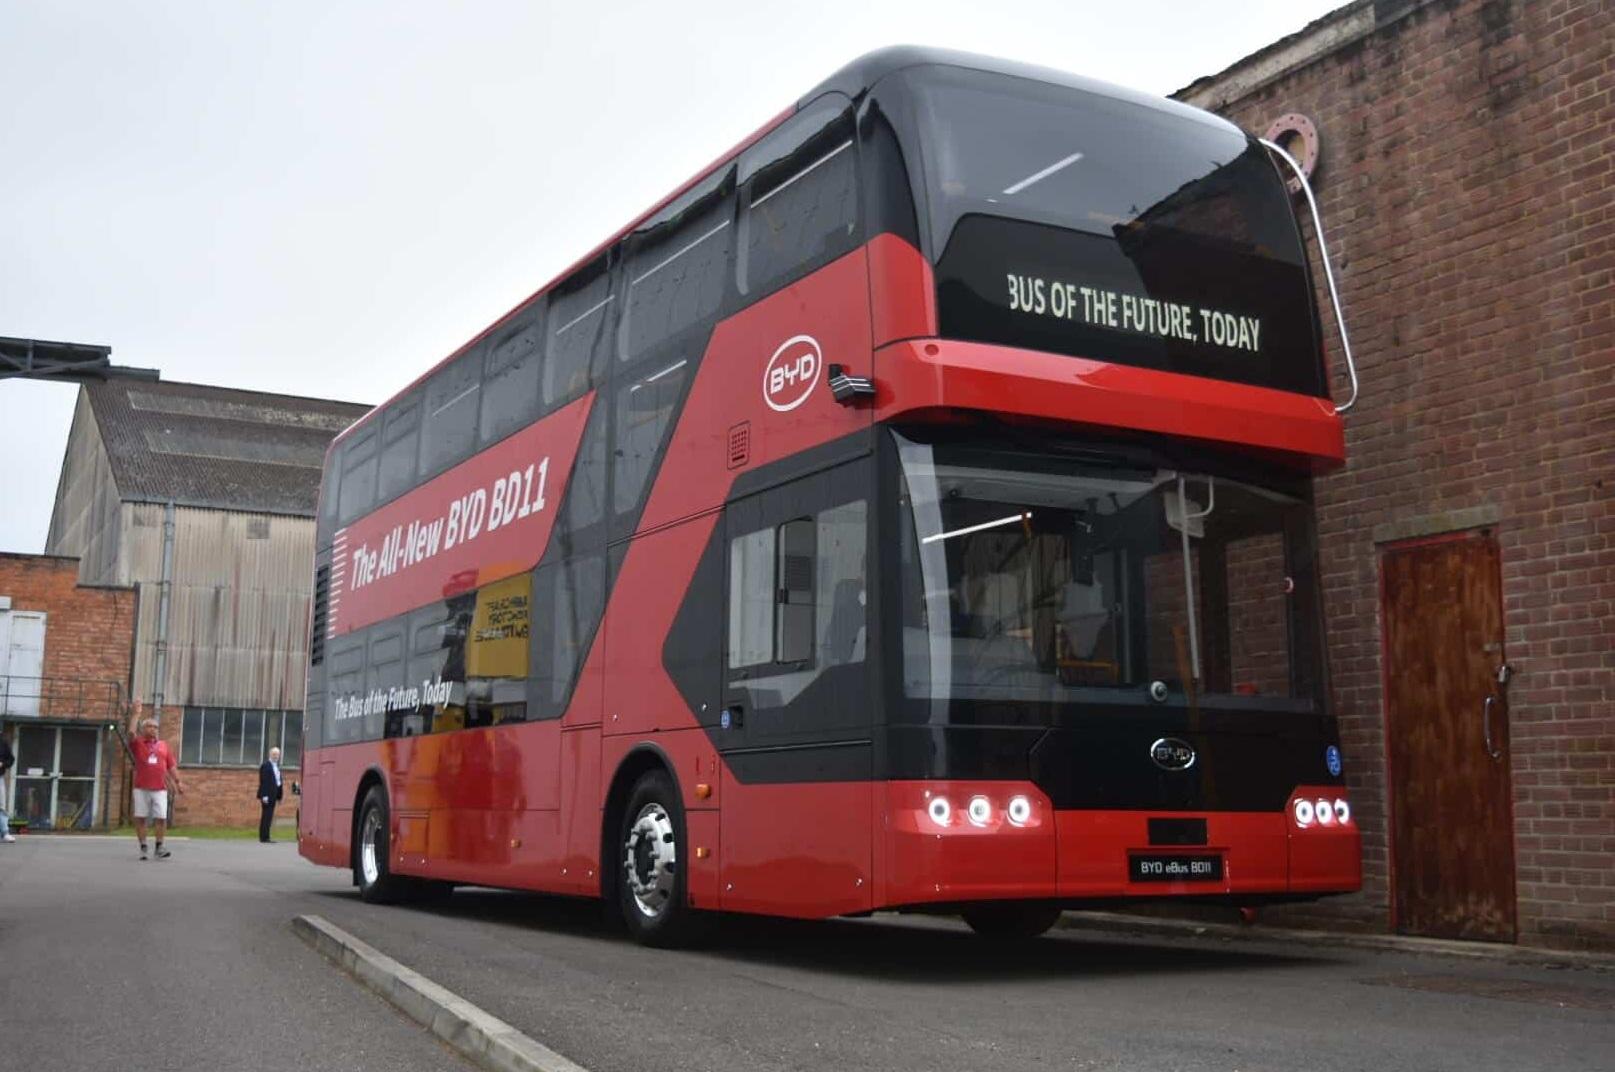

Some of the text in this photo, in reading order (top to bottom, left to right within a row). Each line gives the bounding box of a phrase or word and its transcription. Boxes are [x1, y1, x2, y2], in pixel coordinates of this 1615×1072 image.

[1007, 274, 1046, 315] BUS
[1051, 282, 1077, 319] OF
[1080, 287, 1118, 327] THE
[1200, 309, 1260, 351] TODAY
[770, 353, 815, 394] BYD
[351, 457, 550, 591] The All-New BYD BD11
[335, 676, 453, 720] The Bus of the Future, Today
[1141, 861, 1163, 873] BYD
[1165, 861, 1189, 873] eBus
